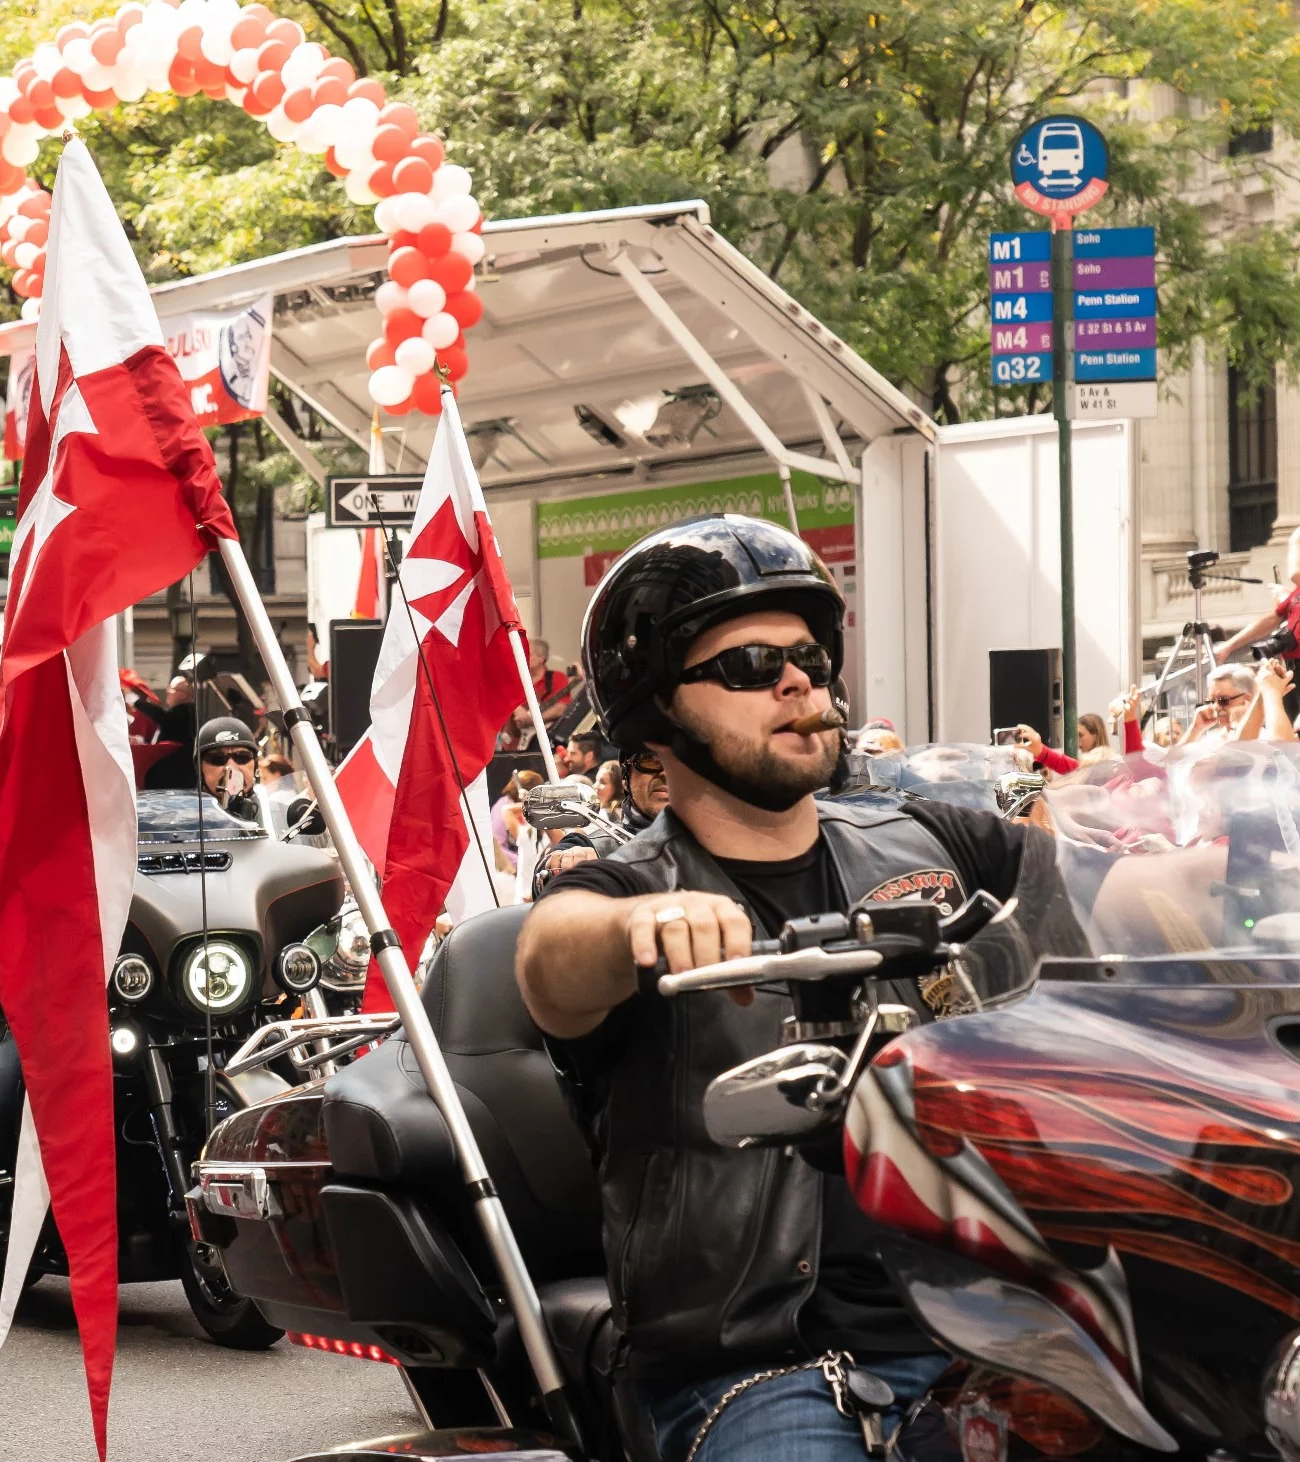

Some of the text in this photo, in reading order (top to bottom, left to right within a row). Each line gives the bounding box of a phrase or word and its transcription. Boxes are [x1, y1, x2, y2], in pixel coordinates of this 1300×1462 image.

[1023, 185, 1101, 211] NO STANDING
[1077, 232, 1101, 245] Soho
[994, 236, 1020, 260] M1
[1077, 263, 1102, 275] Soho
[995, 266, 1024, 289] M1
[995, 296, 1028, 319] M4
[1078, 293, 1140, 306] Penn Station
[1078, 323, 1085, 336] E
[1087, 322, 1100, 335] 32
[1102, 322, 1113, 334] St
[1115, 321, 1123, 334] &
[1134, 321, 1147, 333] Av
[996, 326, 1028, 349] M4
[1080, 352, 1141, 365] Penn Station
[997, 356, 1041, 380] Q32
[1089, 388, 1100, 397] Av
[1103, 387, 1110, 396] &
[1080, 399, 1117, 410] W 41 St
[353, 494, 385, 510] ONE
[872, 872, 954, 901] USARIA
